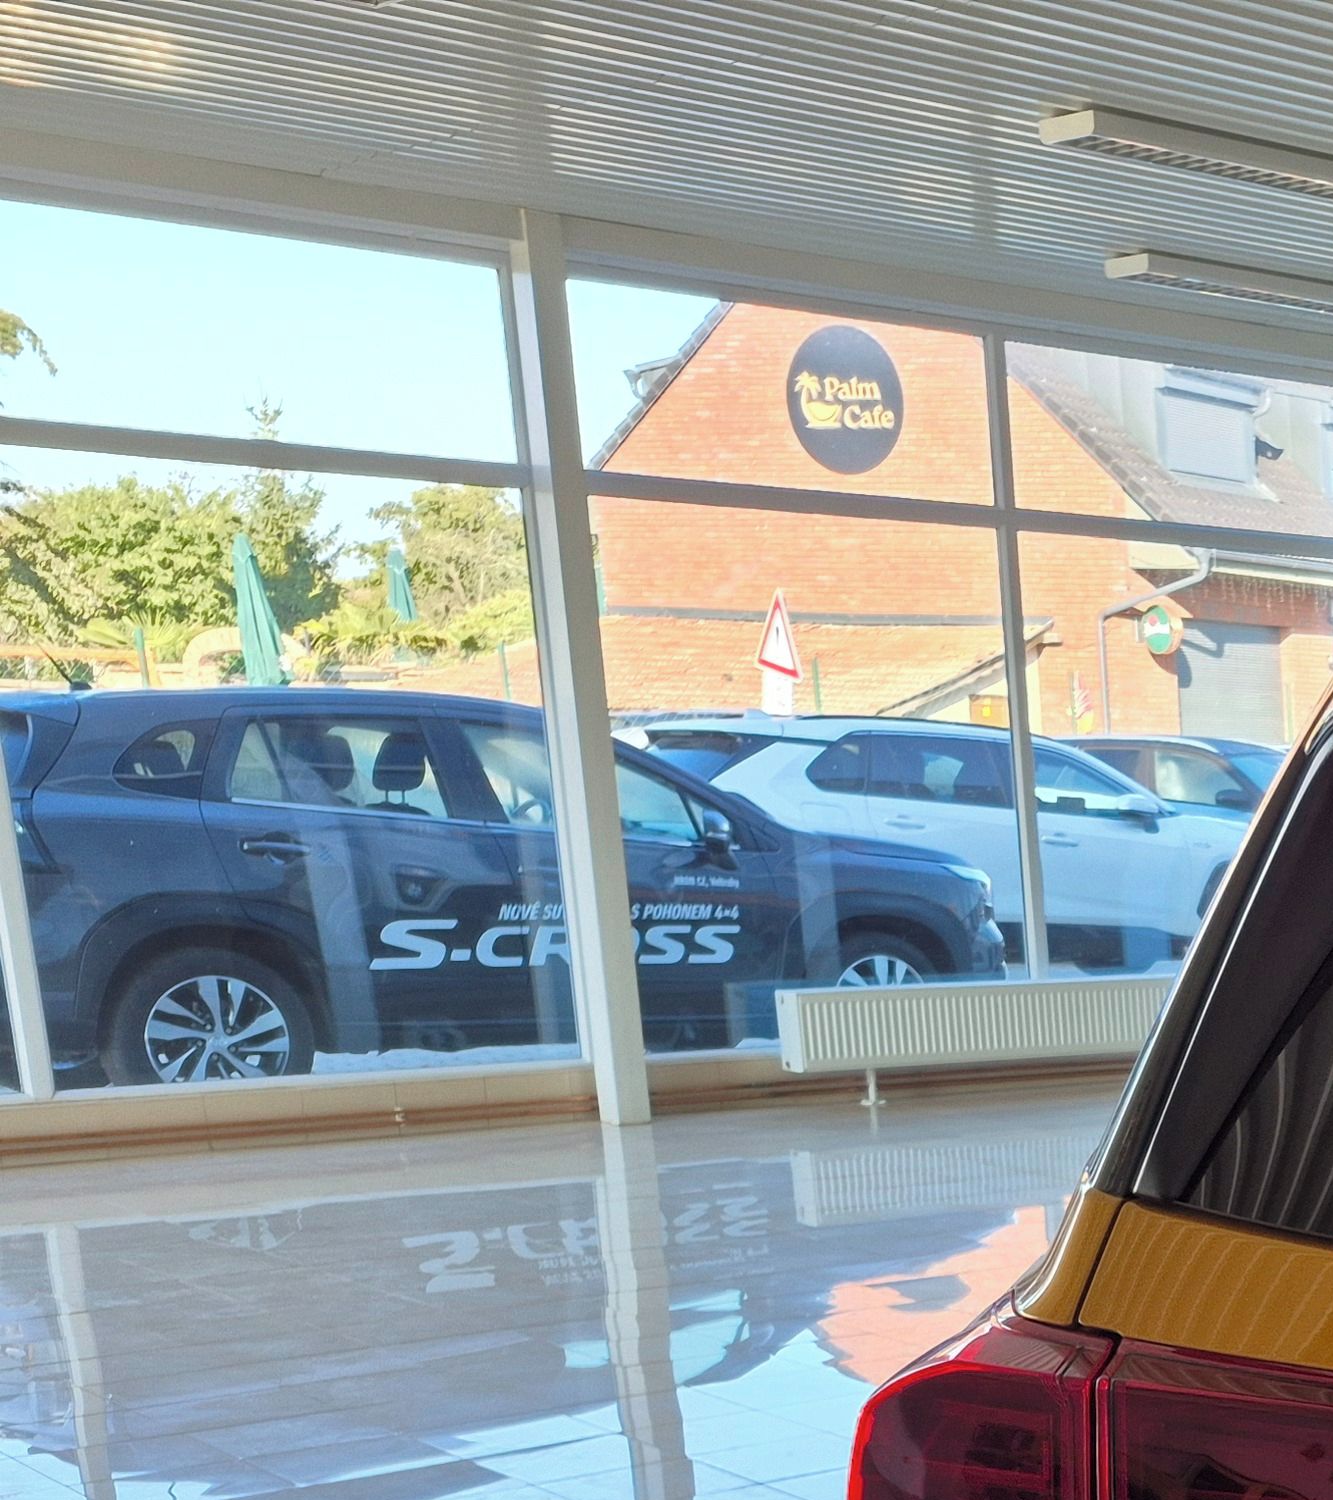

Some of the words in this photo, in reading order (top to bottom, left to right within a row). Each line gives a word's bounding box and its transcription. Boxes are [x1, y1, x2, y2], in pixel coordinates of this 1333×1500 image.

[824, 376, 881, 401] Palm
[843, 404, 895, 429] Cafe
[498, 900, 540, 920] NOVÉ
[642, 903, 712, 920] POHONEM
[369, 918, 741, 970] S-CRSS
